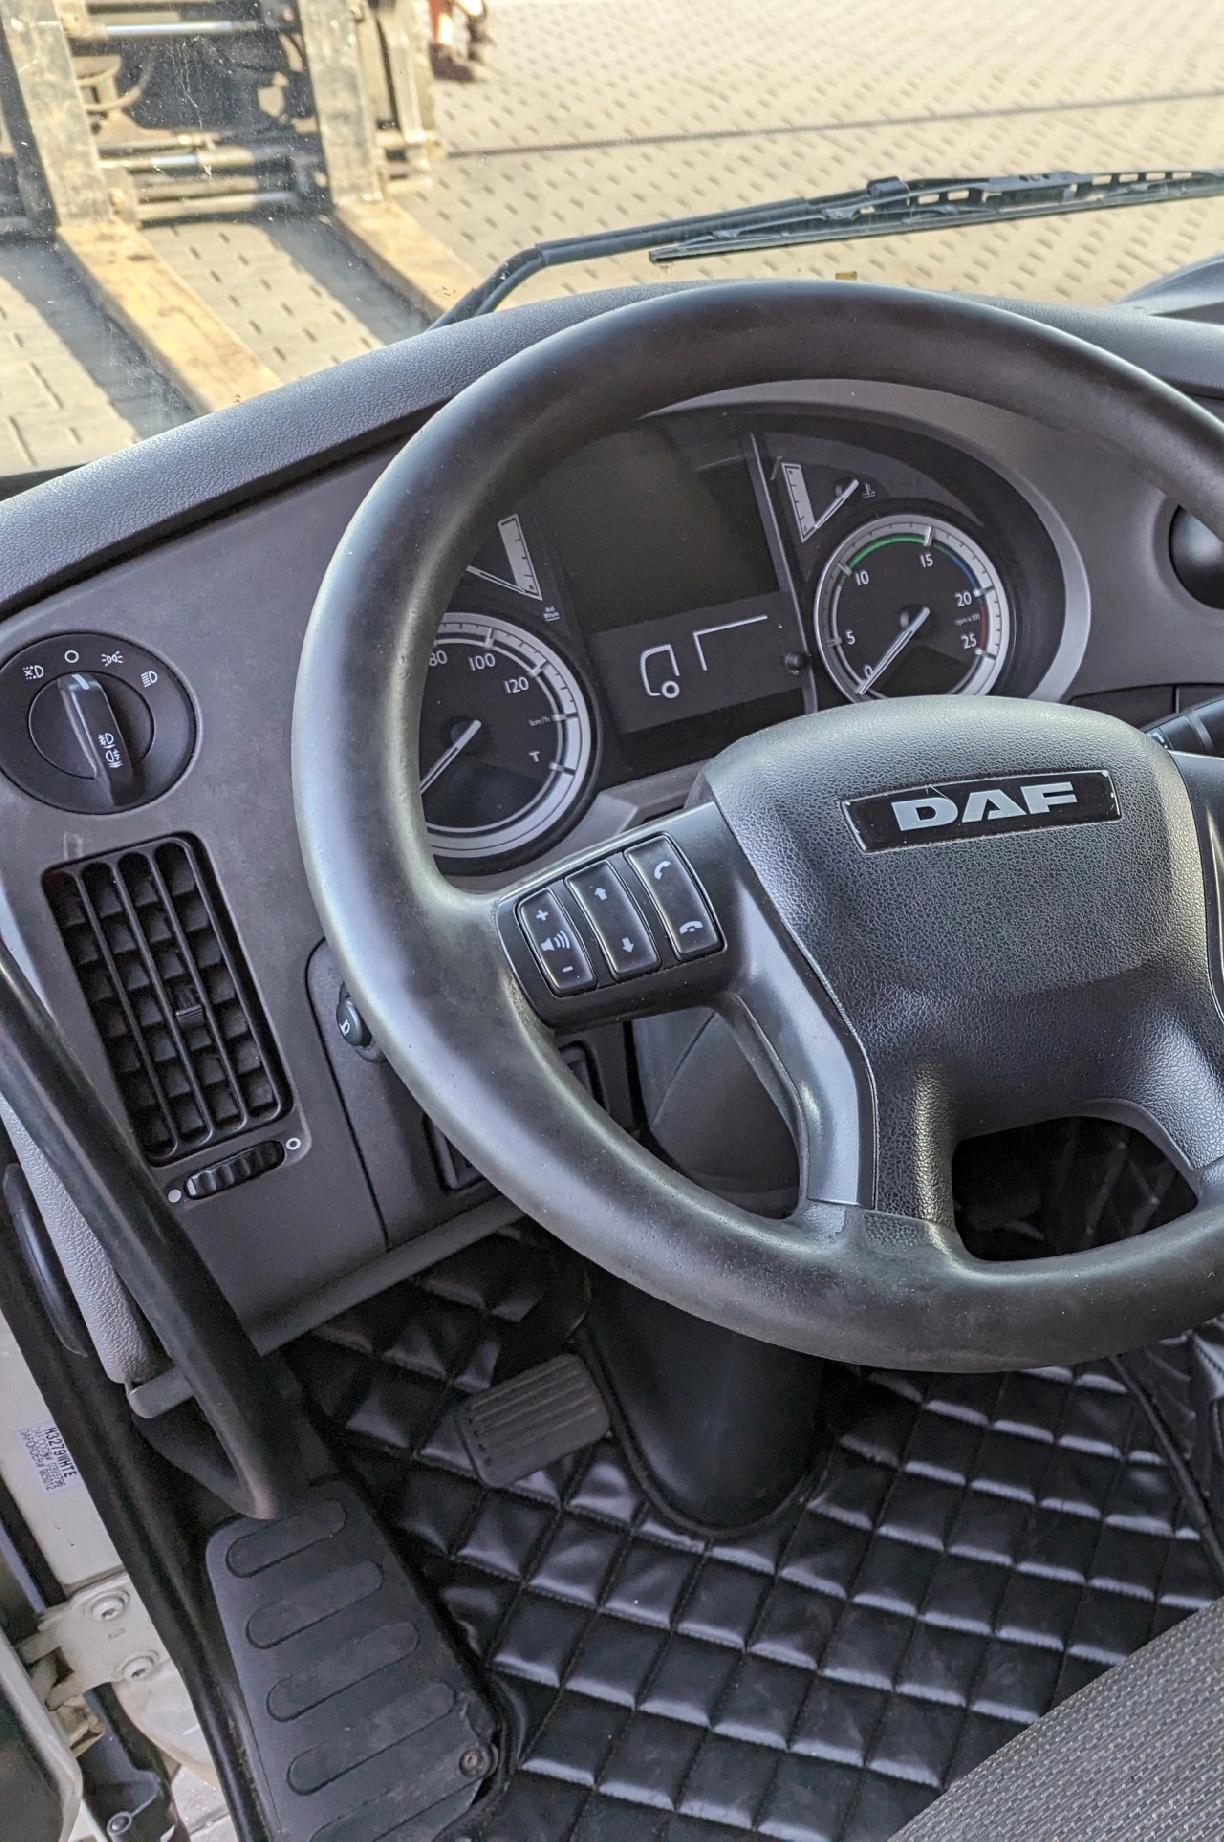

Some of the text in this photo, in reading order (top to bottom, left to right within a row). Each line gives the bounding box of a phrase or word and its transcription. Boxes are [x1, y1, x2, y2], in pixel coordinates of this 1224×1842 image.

[919, 554, 933, 568] 15
[855, 570, 869, 586] 10
[955, 592, 972, 607] 20
[847, 630, 856, 645] 5
[961, 634, 977, 649] 25
[468, 653, 496, 671] 100
[504, 677, 529, 694] 120
[891, 781, 1078, 832] DAF
